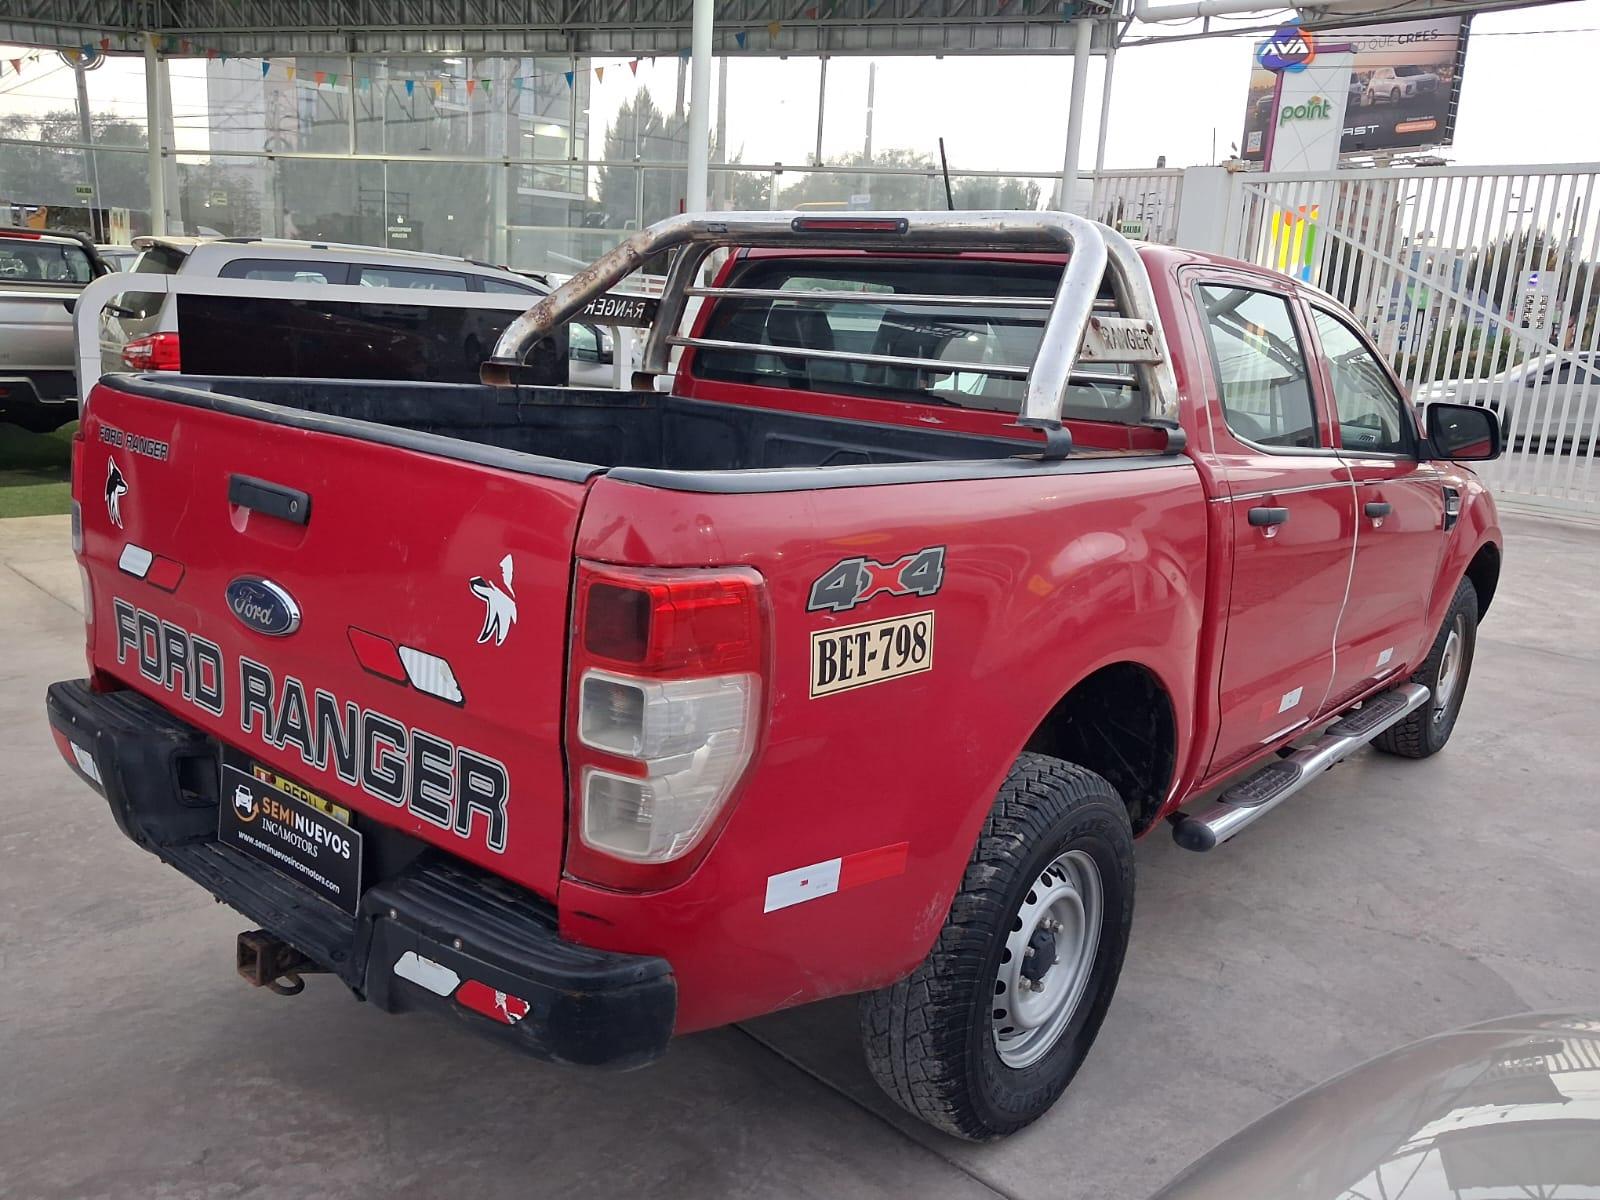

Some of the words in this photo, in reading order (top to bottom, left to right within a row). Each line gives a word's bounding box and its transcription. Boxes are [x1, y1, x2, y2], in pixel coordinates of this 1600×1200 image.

[1261, 38, 1309, 57] AVA
[1398, 28, 1439, 45] CREES
[1279, 96, 1330, 127] point
[1122, 224, 1141, 235] SALIDA
[1100, 325, 1152, 351] RANGER
[99, 423, 124, 449] FORD
[125, 432, 169, 462] RANGER
[233, 586, 274, 626] Ford
[816, 620, 928, 687] BET-798
[112, 596, 225, 718] FORD
[239, 655, 511, 855] RANGER
[261, 817, 318, 858] INCAMOTORS
[262, 797, 351, 860] SEMINUEVOS
[237, 830, 341, 895] www.seminuevosincamotors.com
